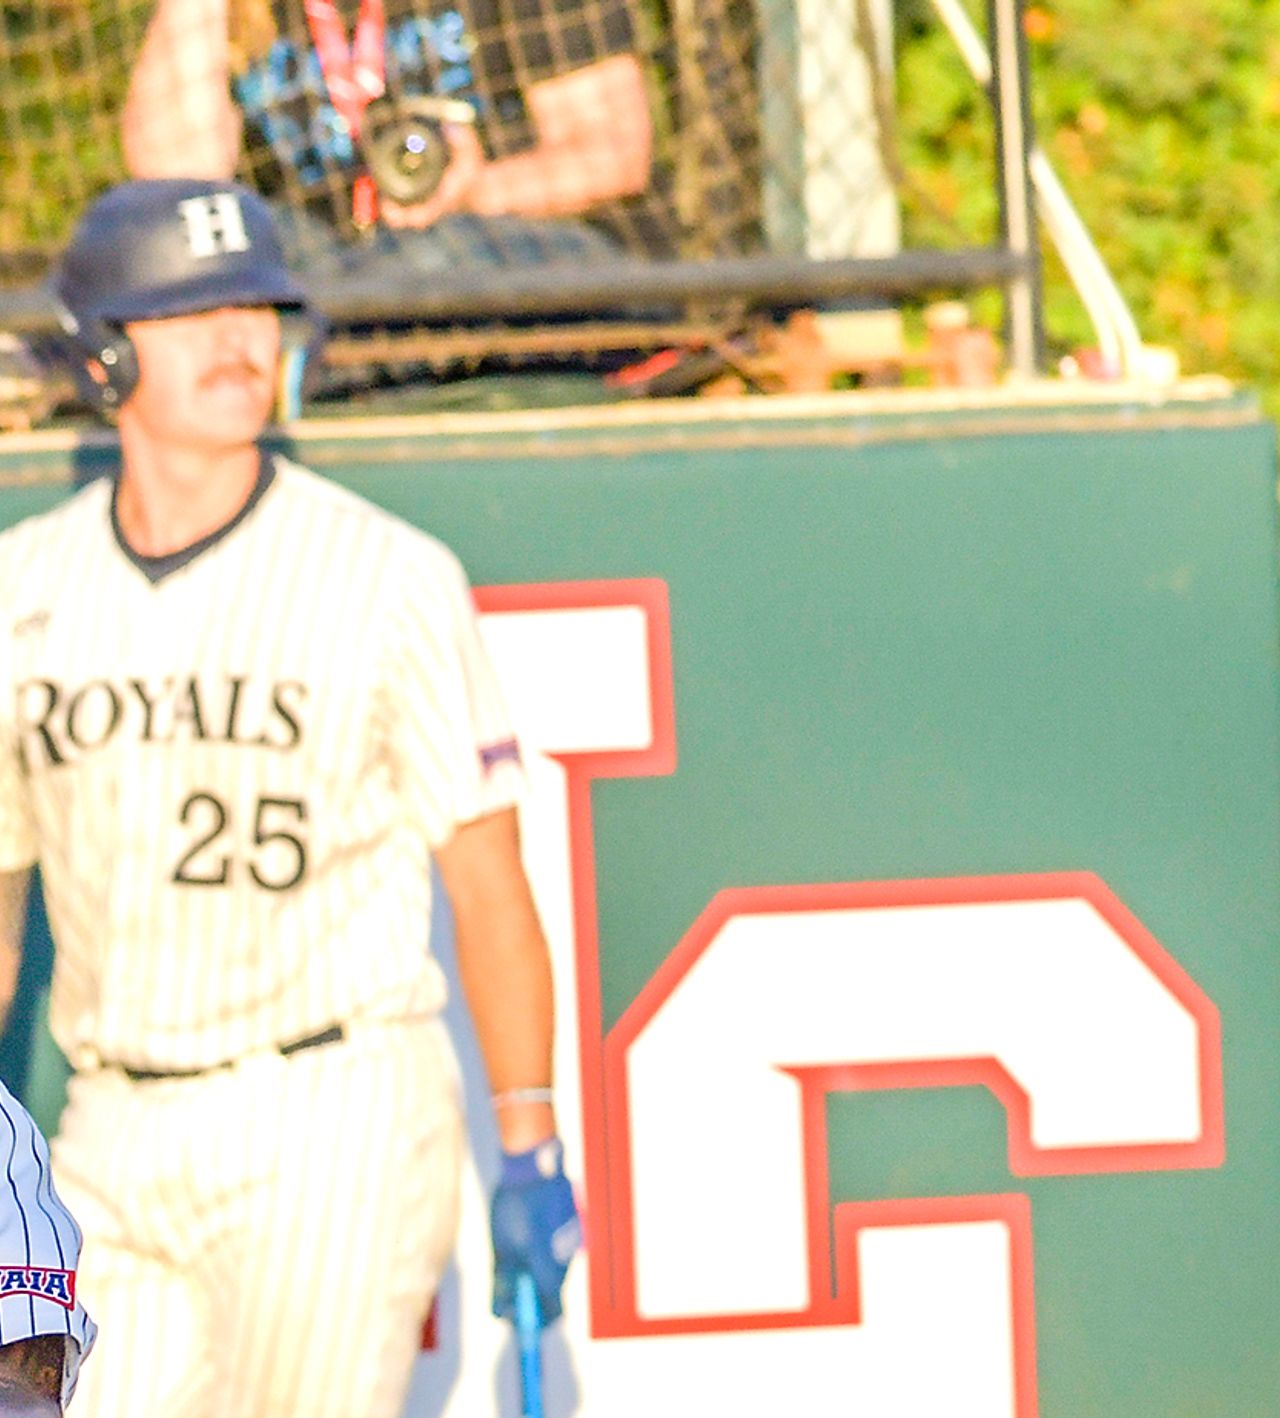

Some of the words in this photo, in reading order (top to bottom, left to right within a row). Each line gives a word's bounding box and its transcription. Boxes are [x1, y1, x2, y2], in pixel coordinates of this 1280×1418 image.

[177, 192, 251, 258] H
[14, 672, 309, 768] ROYALS
[171, 790, 308, 893] 25
